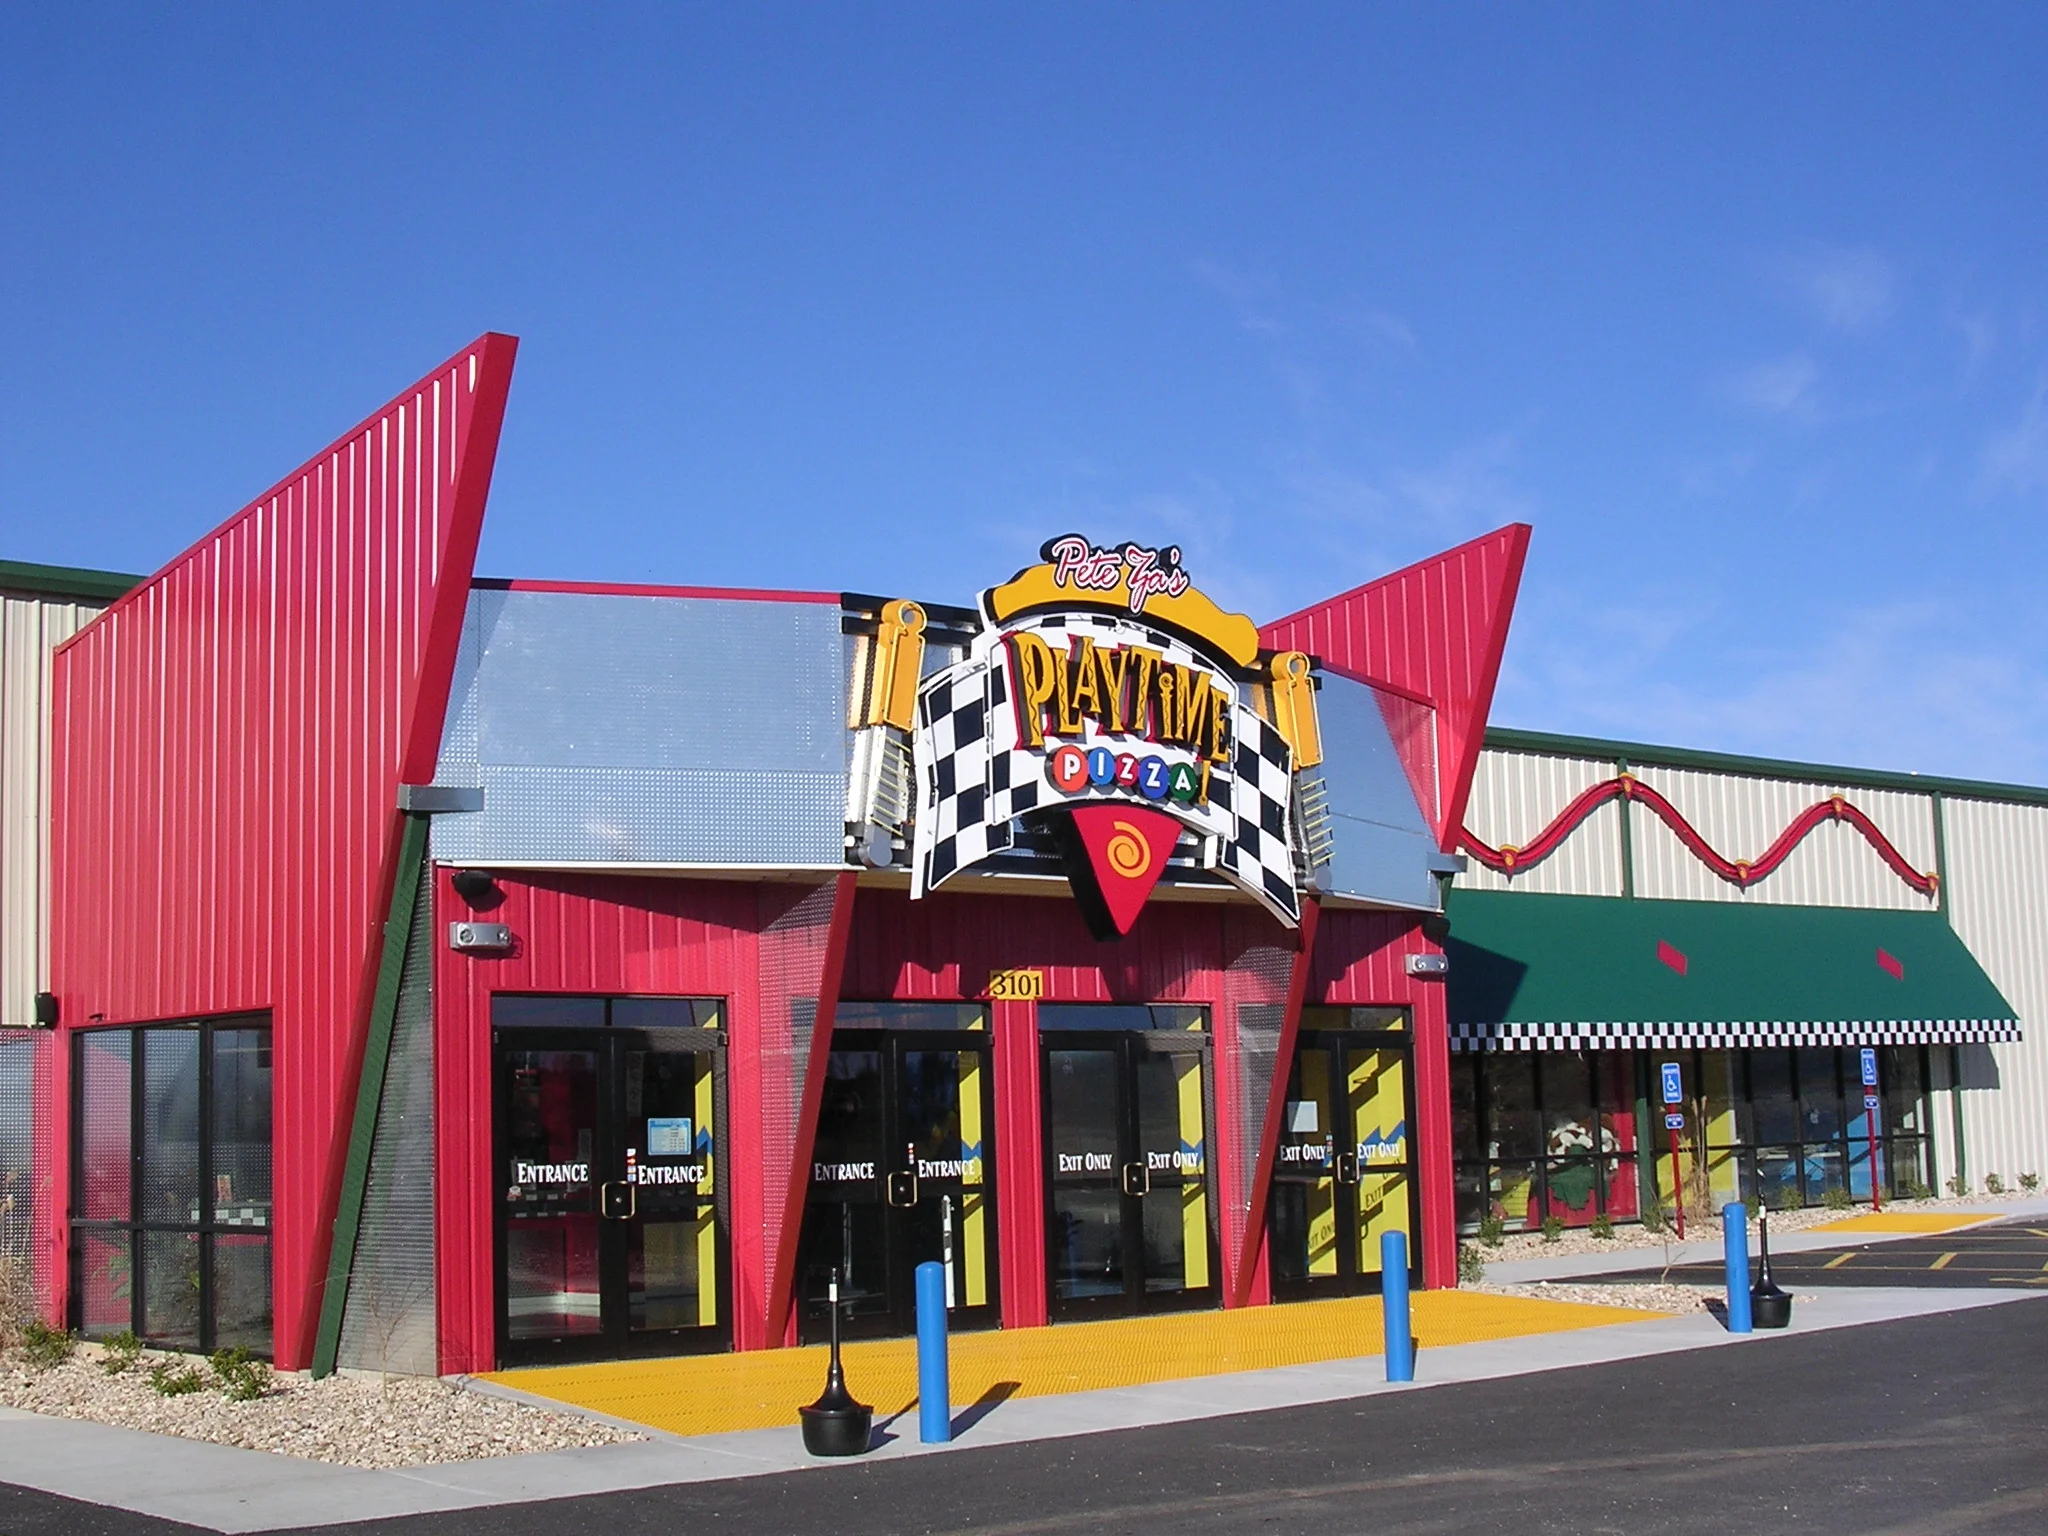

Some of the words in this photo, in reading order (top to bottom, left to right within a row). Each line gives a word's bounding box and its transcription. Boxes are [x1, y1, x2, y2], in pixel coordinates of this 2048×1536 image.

[1052, 537, 1122, 587] Pete
[1125, 545, 1188, 613] Za's
[992, 974, 1041, 996] 3101
[1059, 1154, 1083, 1172] EXIT
[1085, 1152, 1112, 1171] ONLY
[1147, 1152, 1170, 1169] EXIT
[1172, 1151, 1199, 1168] ONLY
[1280, 1145, 1300, 1162] EXIT
[1303, 1143, 1327, 1161] ONLY
[517, 1163, 589, 1183] ENTRANCE
[637, 1165, 705, 1184] ENTRANCE
[814, 1162, 875, 1181] ENTRANCE
[918, 1160, 975, 1178] ENTRANCE
